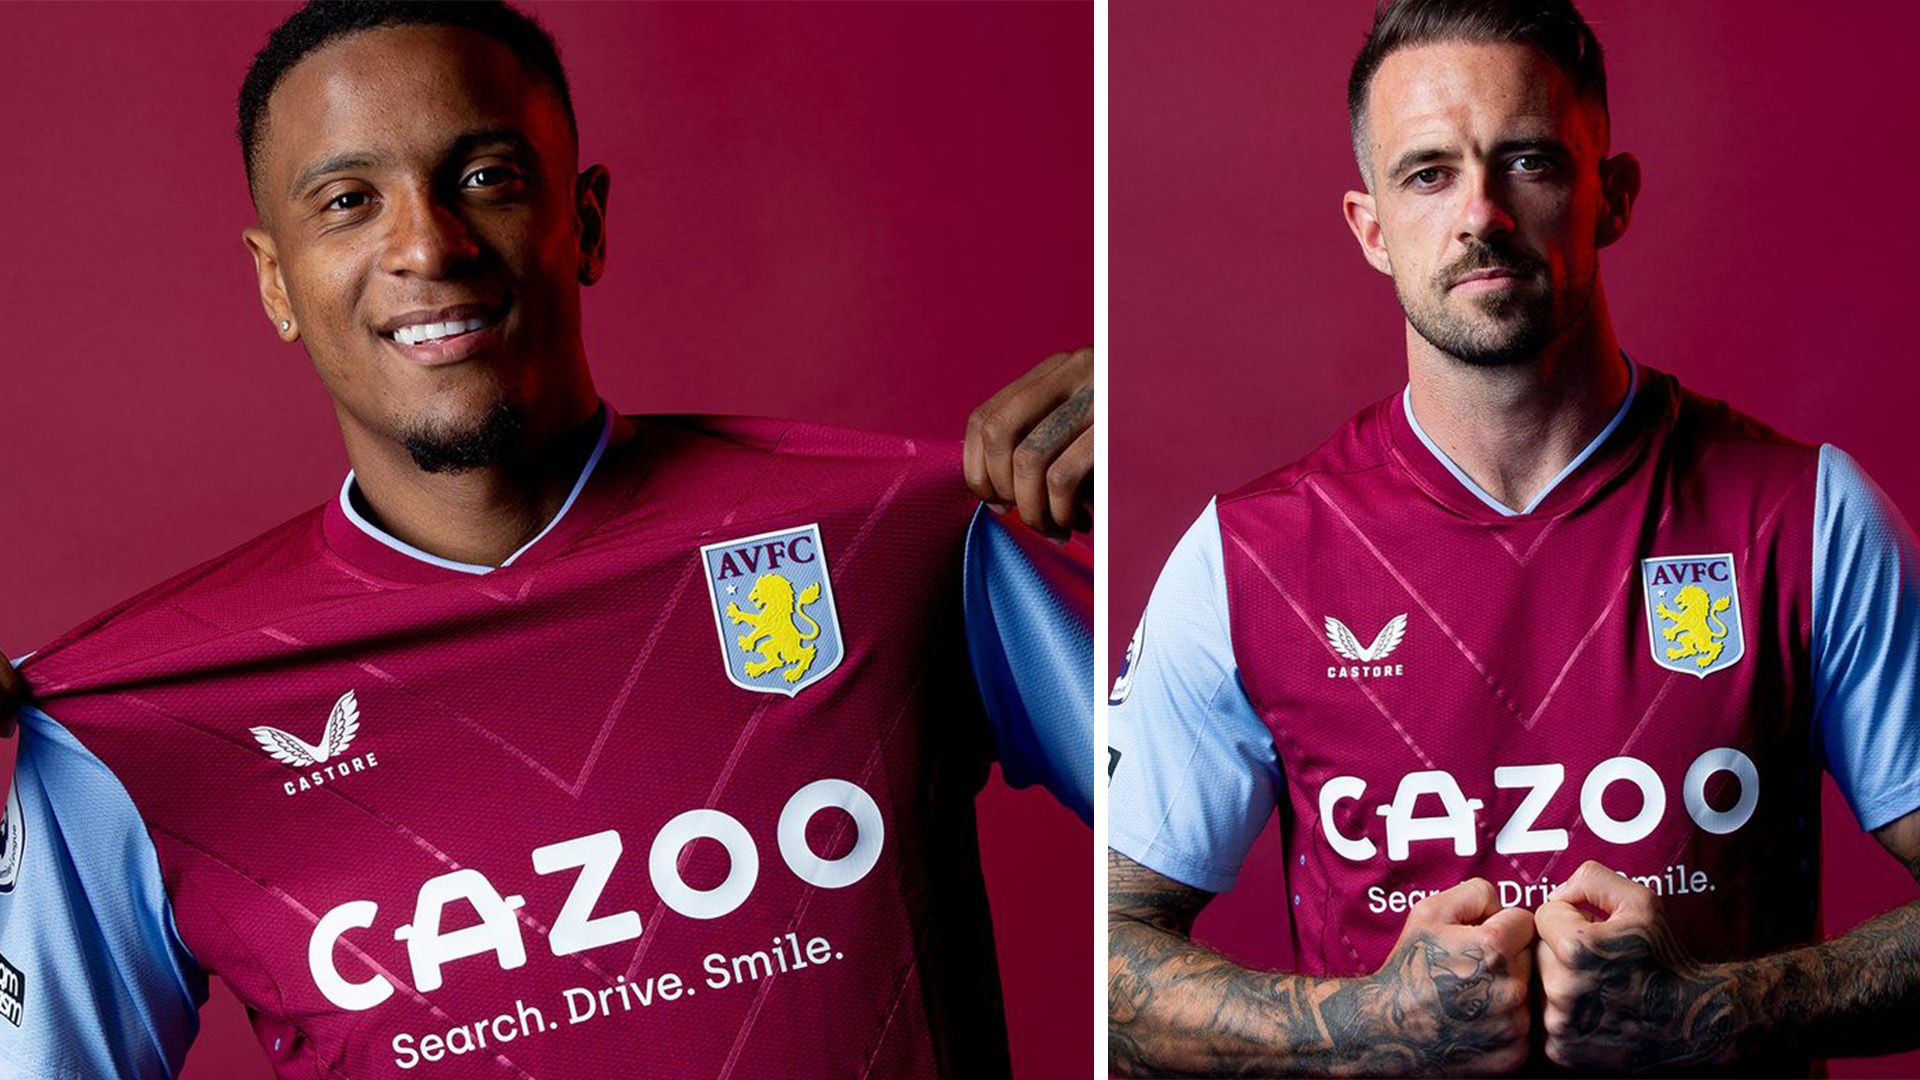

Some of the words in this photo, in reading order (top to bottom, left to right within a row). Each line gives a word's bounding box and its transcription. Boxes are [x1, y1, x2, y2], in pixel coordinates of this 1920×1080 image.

[717, 536, 815, 580] AVFC
[1652, 561, 1729, 586] AVFC
[1327, 664, 1404, 679] CASTORE
[284, 752, 378, 795] CASTORE
[1318, 747, 1760, 861] CAZOO
[308, 778, 885, 1011] CAZOO
[1497, 876, 1558, 909] Dri
[1615, 864, 1716, 897] mile.
[391, 999, 559, 1070] Search.
[562, 975, 696, 1025] Drive.
[702, 932, 844, 990] Smile.
